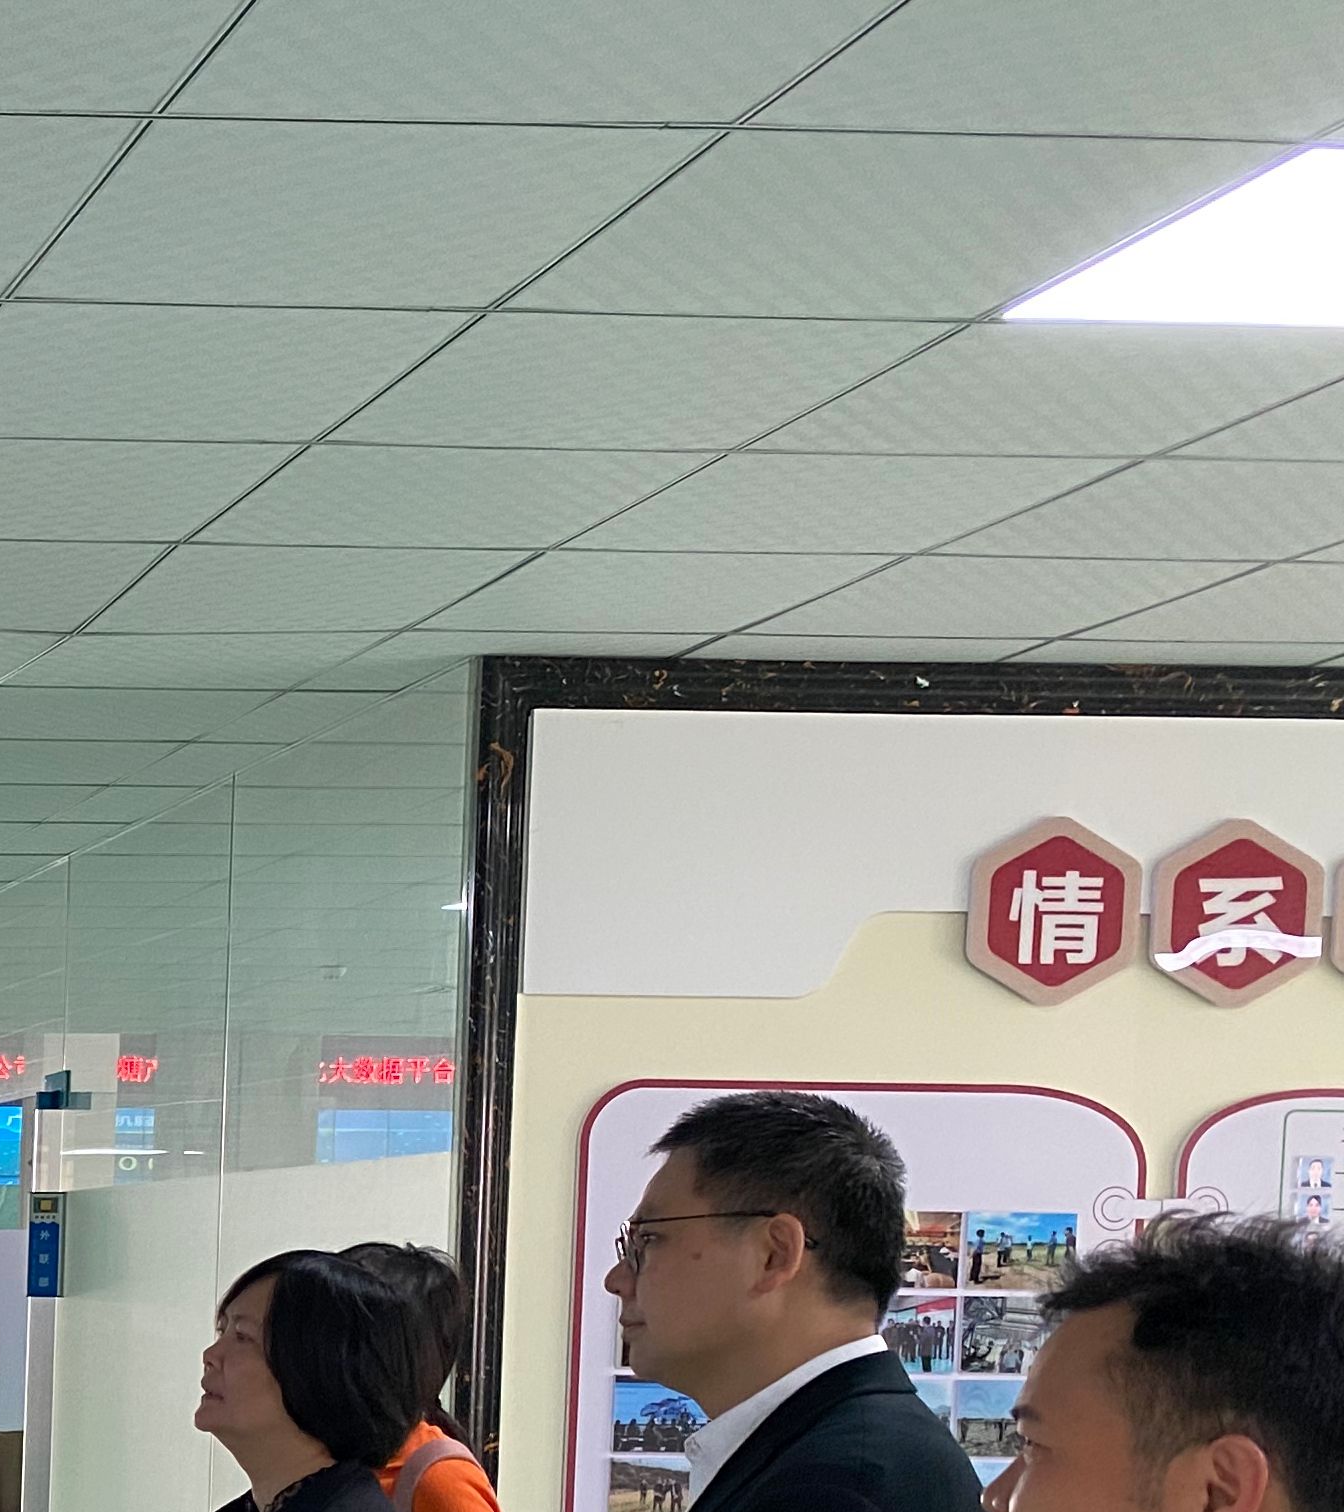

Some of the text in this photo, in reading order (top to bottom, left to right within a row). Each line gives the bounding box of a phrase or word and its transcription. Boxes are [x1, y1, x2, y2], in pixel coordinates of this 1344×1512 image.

[318, 1056, 456, 1085] 大数据平台
